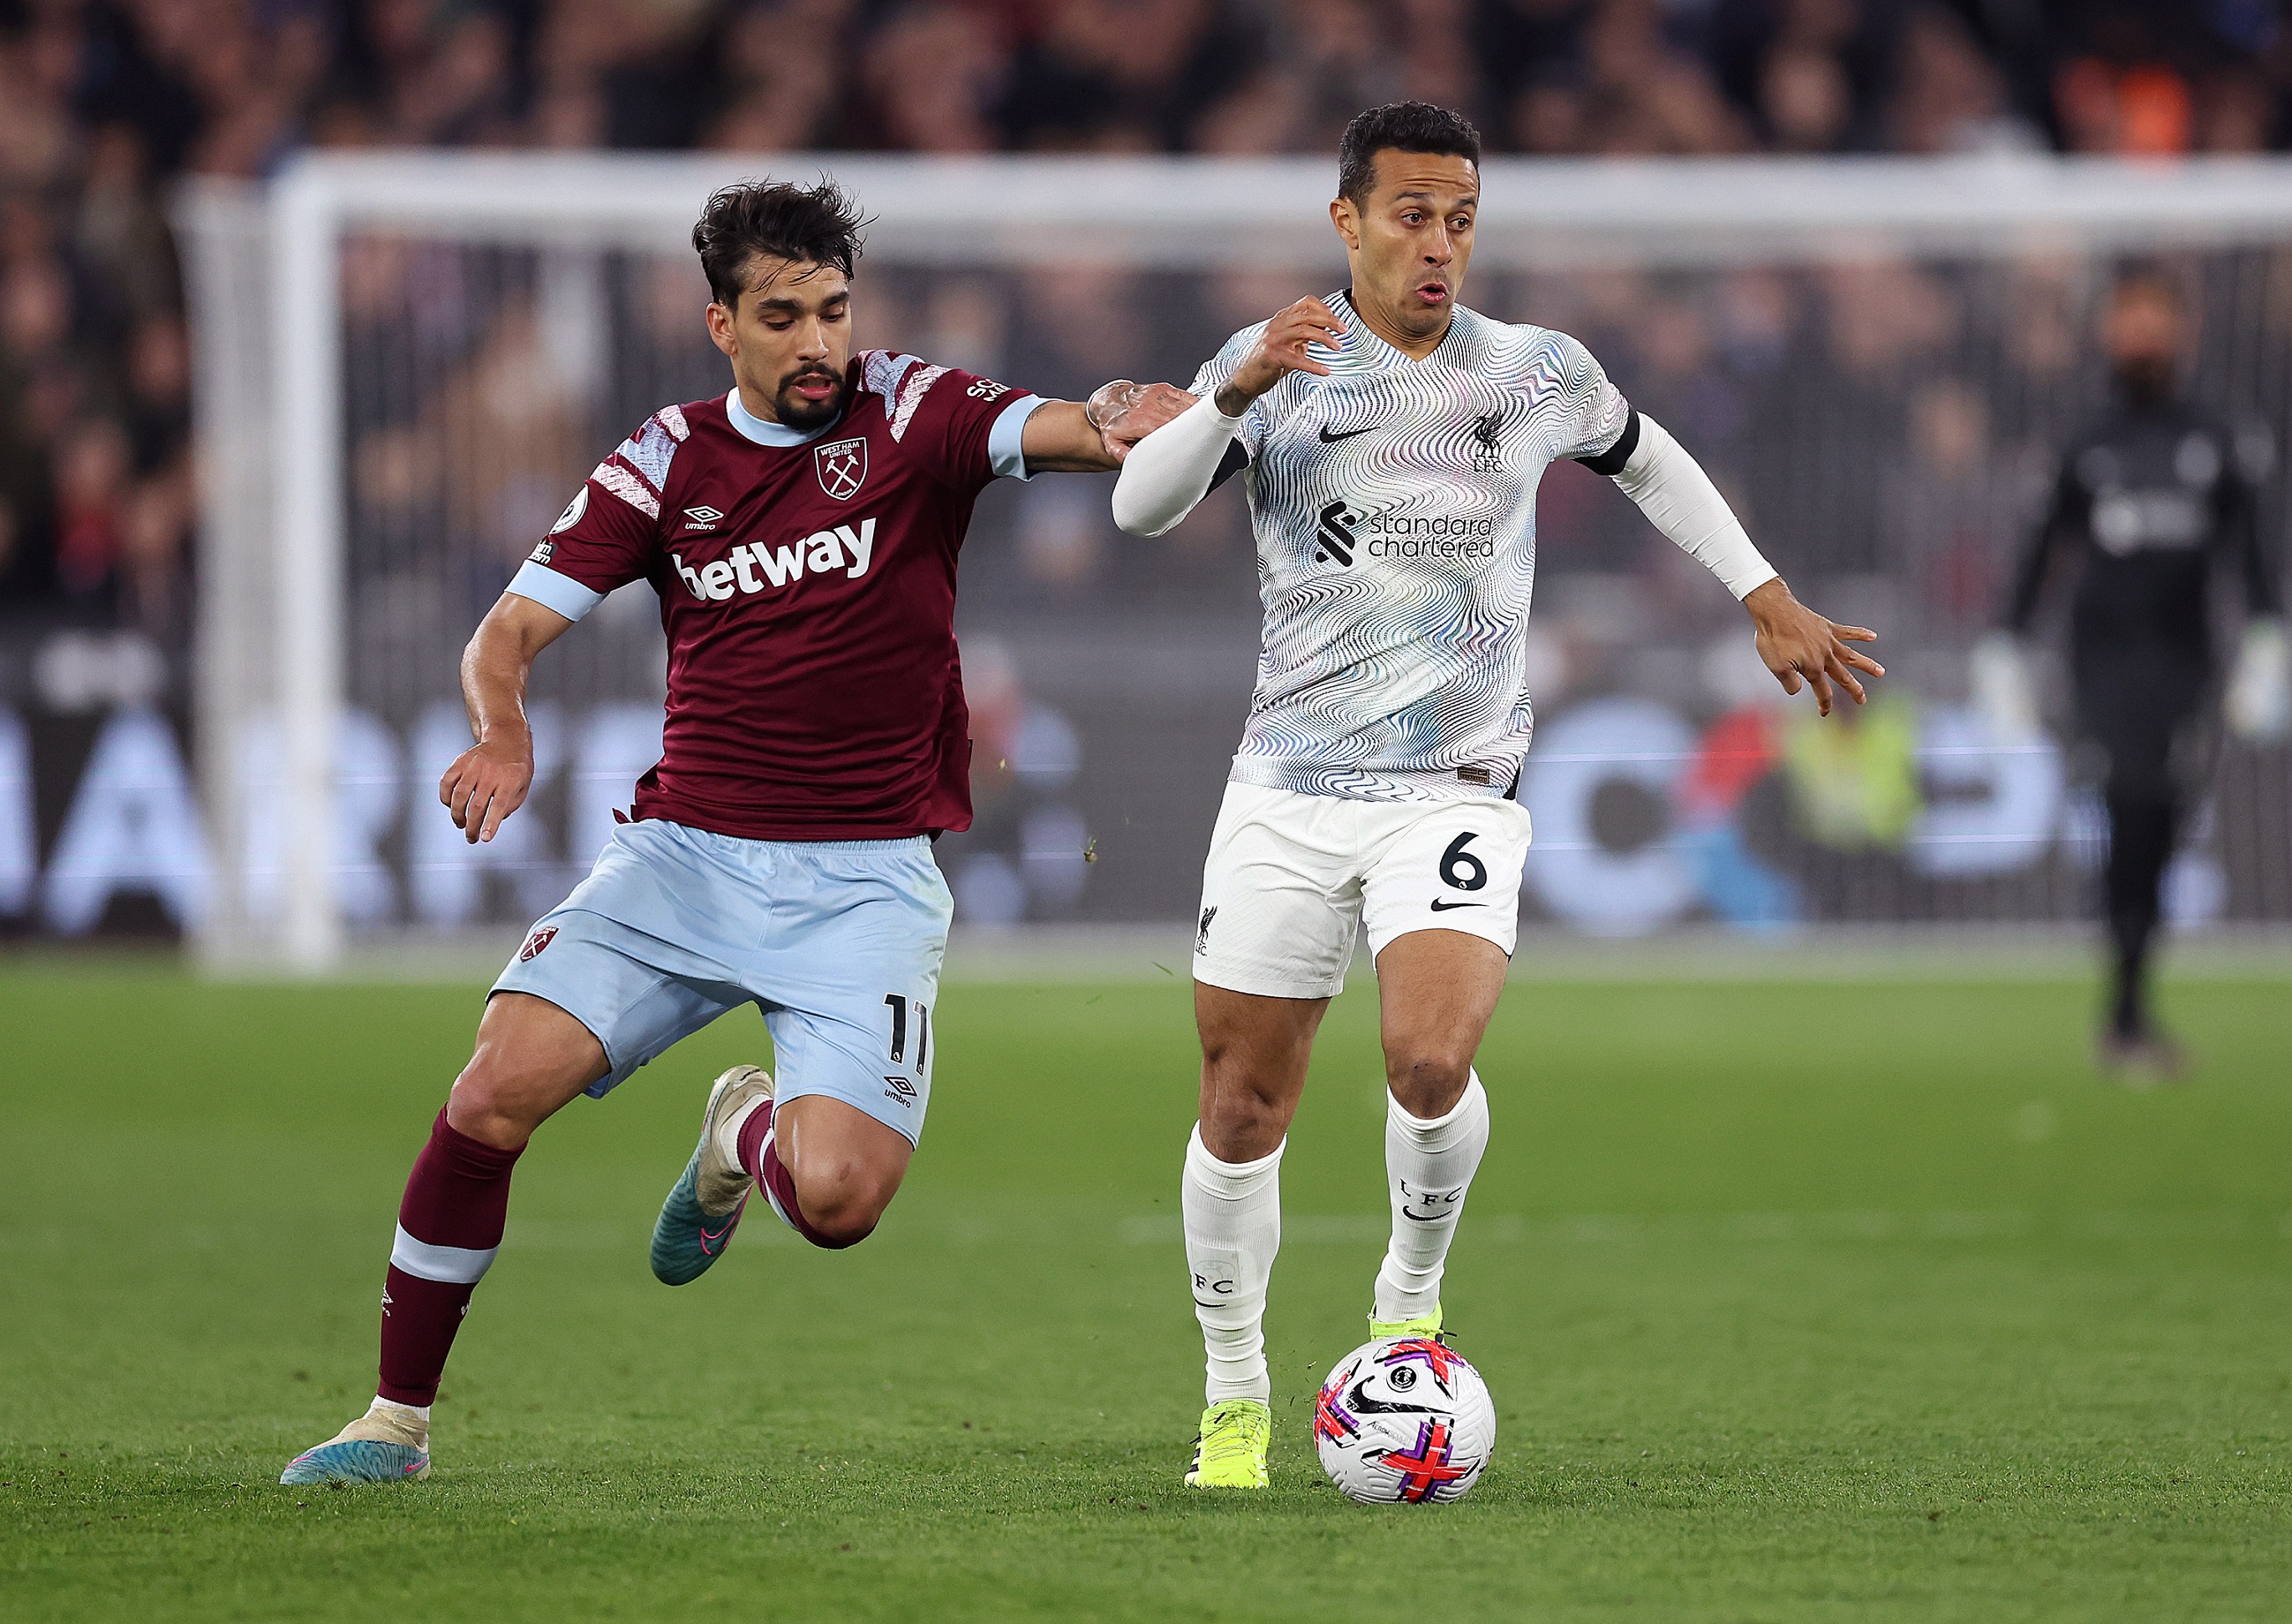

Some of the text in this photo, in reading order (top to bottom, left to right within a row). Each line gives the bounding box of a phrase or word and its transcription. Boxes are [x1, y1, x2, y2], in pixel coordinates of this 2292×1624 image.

[820, 441, 860, 456] WEST HAM
[829, 449, 852, 459] UNITED
[1473, 460, 1503, 473] LFC
[685, 522, 717, 531] umbro
[1370, 512, 1493, 536] standard
[1368, 536, 1494, 558] chartered
[672, 517, 876, 601] betway
[1439, 831, 1488, 892] 6
[882, 993, 928, 1078] 11
[884, 1089, 912, 1108] umbro
[1400, 1178, 1462, 1206] LFC
[1190, 1272, 1233, 1294] FC
